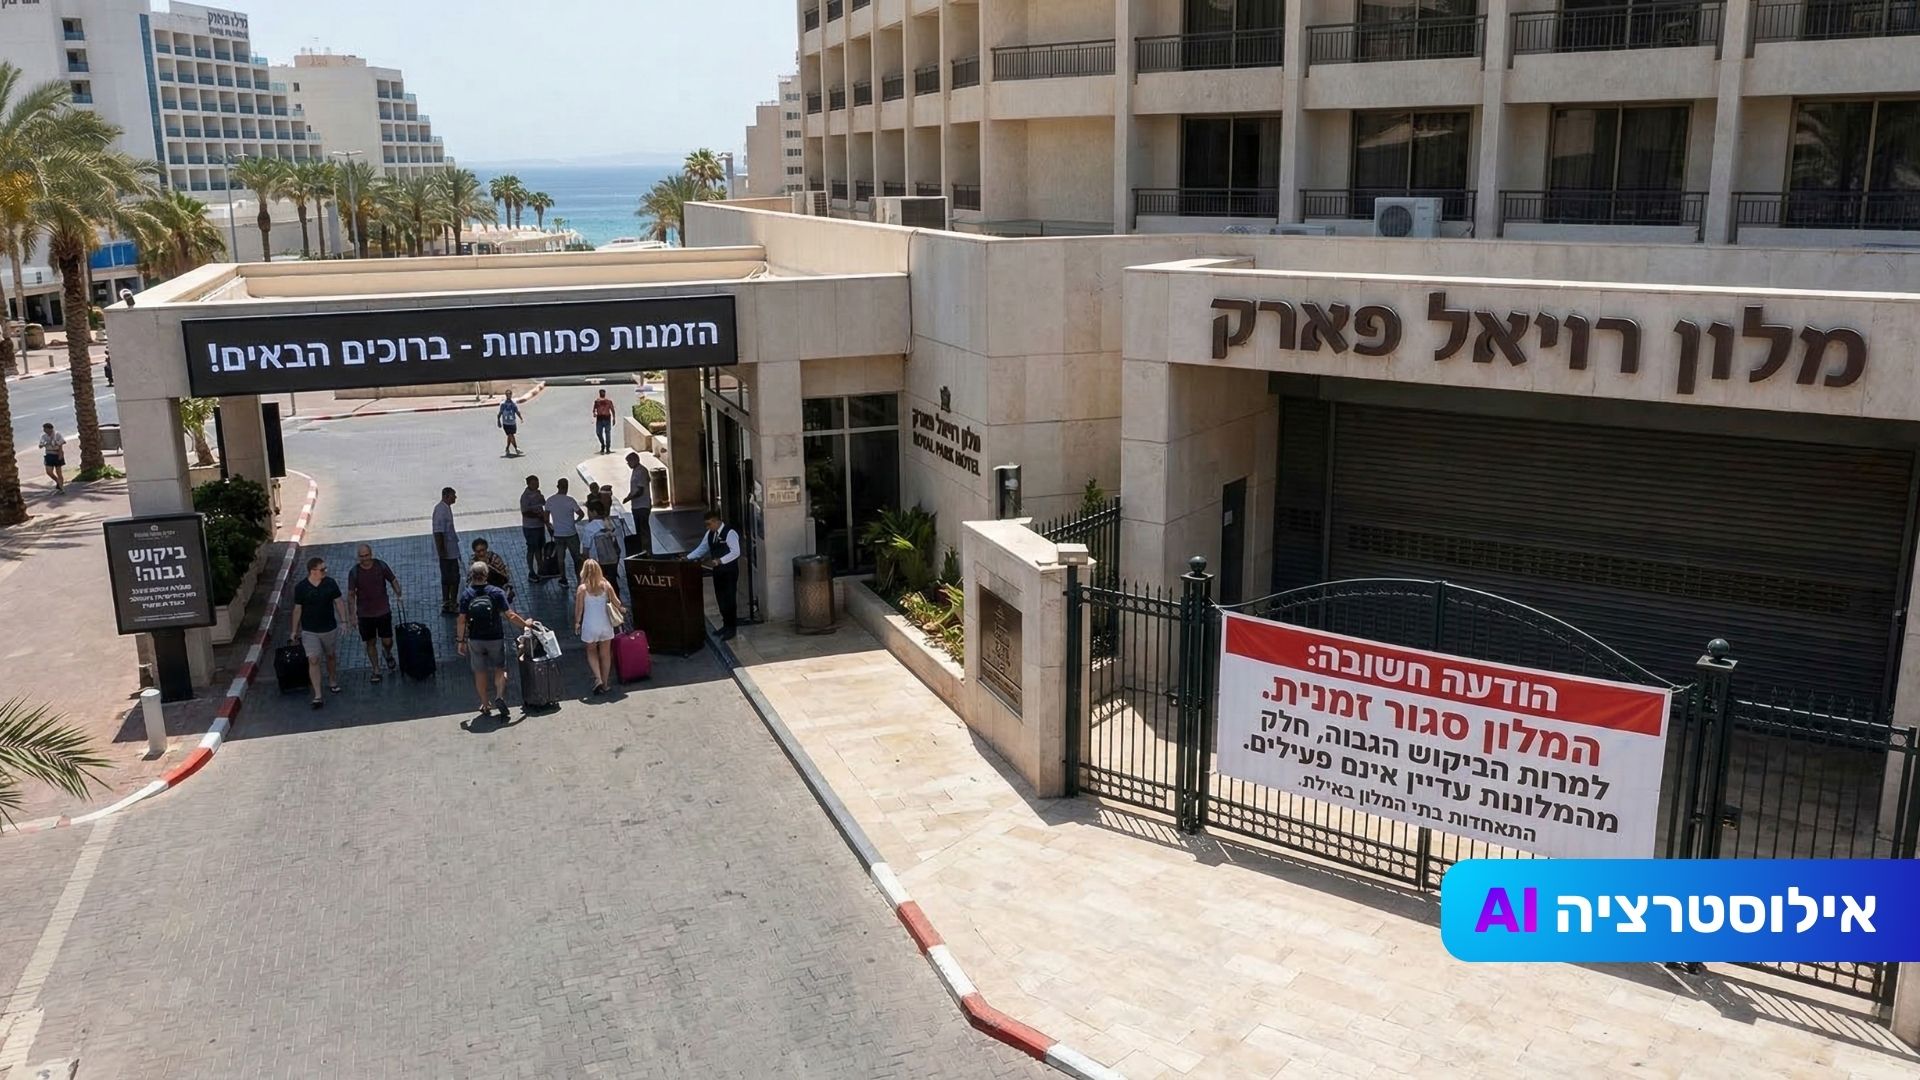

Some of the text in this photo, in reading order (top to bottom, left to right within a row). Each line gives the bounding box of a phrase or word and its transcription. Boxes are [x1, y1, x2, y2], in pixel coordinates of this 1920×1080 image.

[341, 336, 451, 366] ברוכים
[482, 328, 601, 358] פתוחות
[610, 321, 719, 350] הזמנות
[1210, 291, 1869, 395] מלון רויאל פארק
[208, 342, 330, 373] הבאים!
[961, 426, 981, 453] מלון
[936, 441, 955, 463] PARK
[955, 451, 981, 476] HOTEL
[128, 546, 187, 565] ביקוש
[135, 565, 185, 582] גבוה!
[633, 574, 674, 587] VALET
[1307, 645, 1558, 712] הודעה חשובה:
[1262, 676, 1601, 767] המלון סגור זמנית.
[1261, 709, 1610, 801] למרות הביקוש הגבוה, חלק
[1243, 734, 1619, 834] מהמלונות עדיין אינם פעילים.
[1298, 775, 1536, 842] התאחדות בתי המלון באילת.
